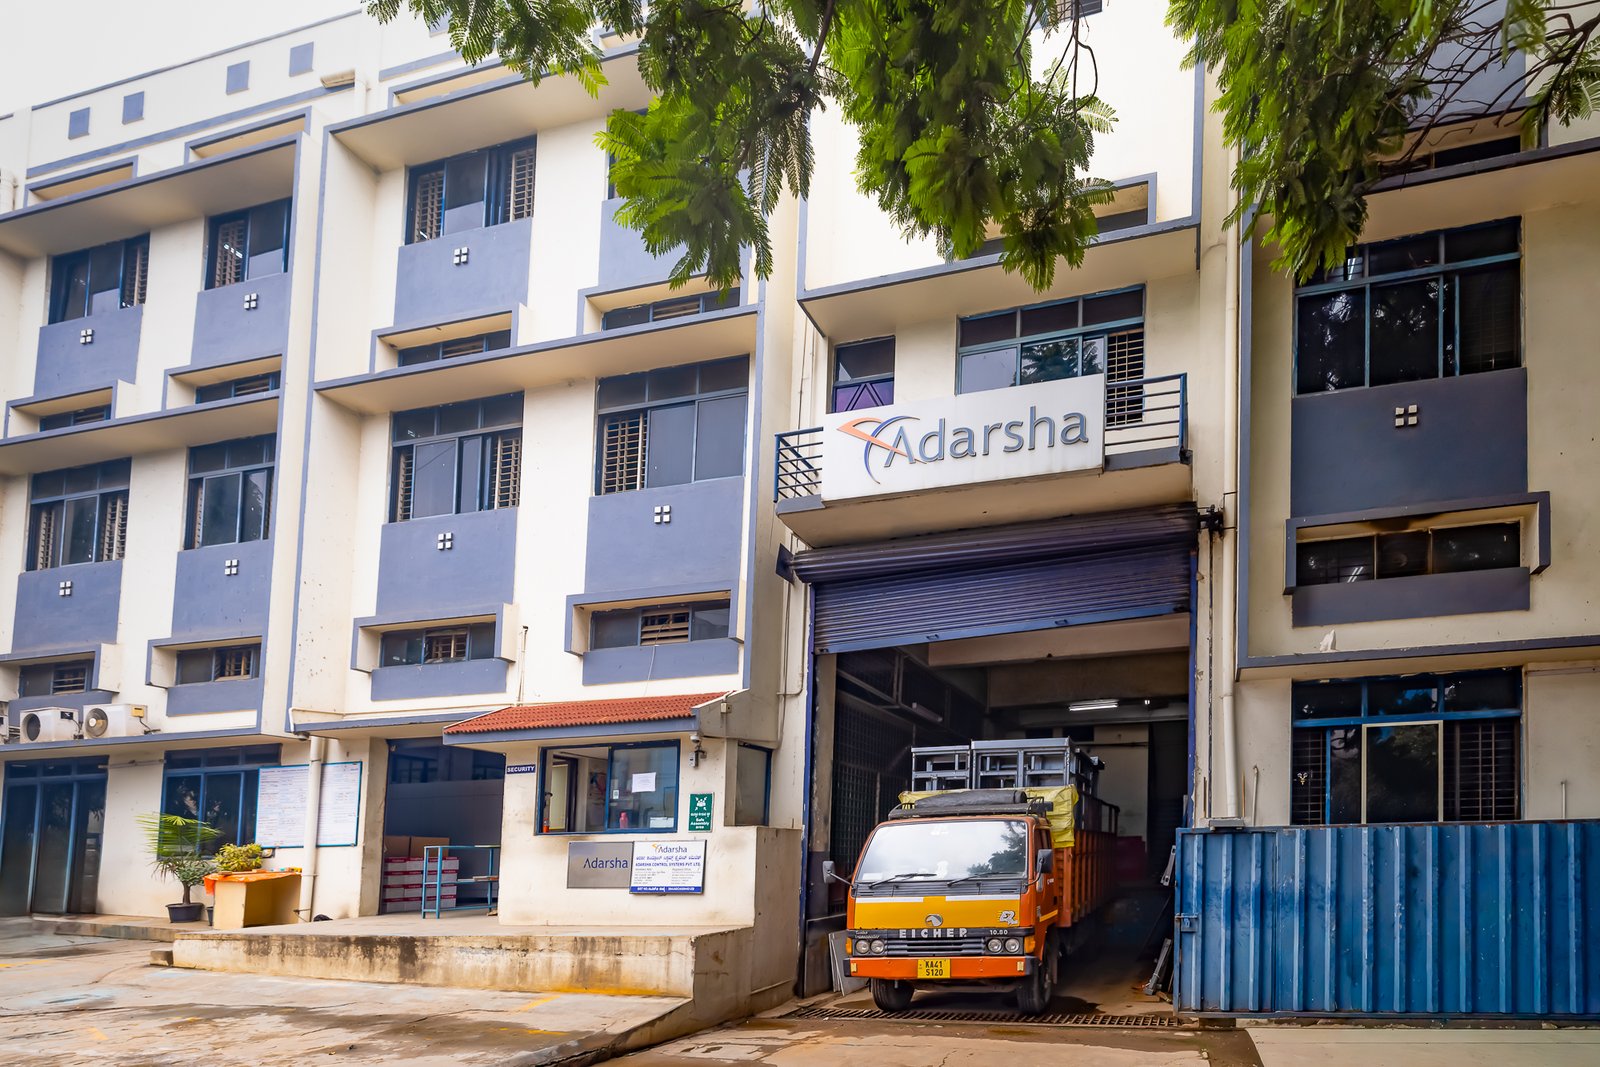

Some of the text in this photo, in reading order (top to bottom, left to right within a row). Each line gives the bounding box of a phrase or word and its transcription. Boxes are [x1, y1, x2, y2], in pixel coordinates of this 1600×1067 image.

[883, 405, 1089, 468] Adarsha
[507, 765, 535, 773] SECURITY
[583, 857, 629, 869] Adarsha
[899, 928, 968, 938] EICHER
[925, 960, 943, 968] KA41
